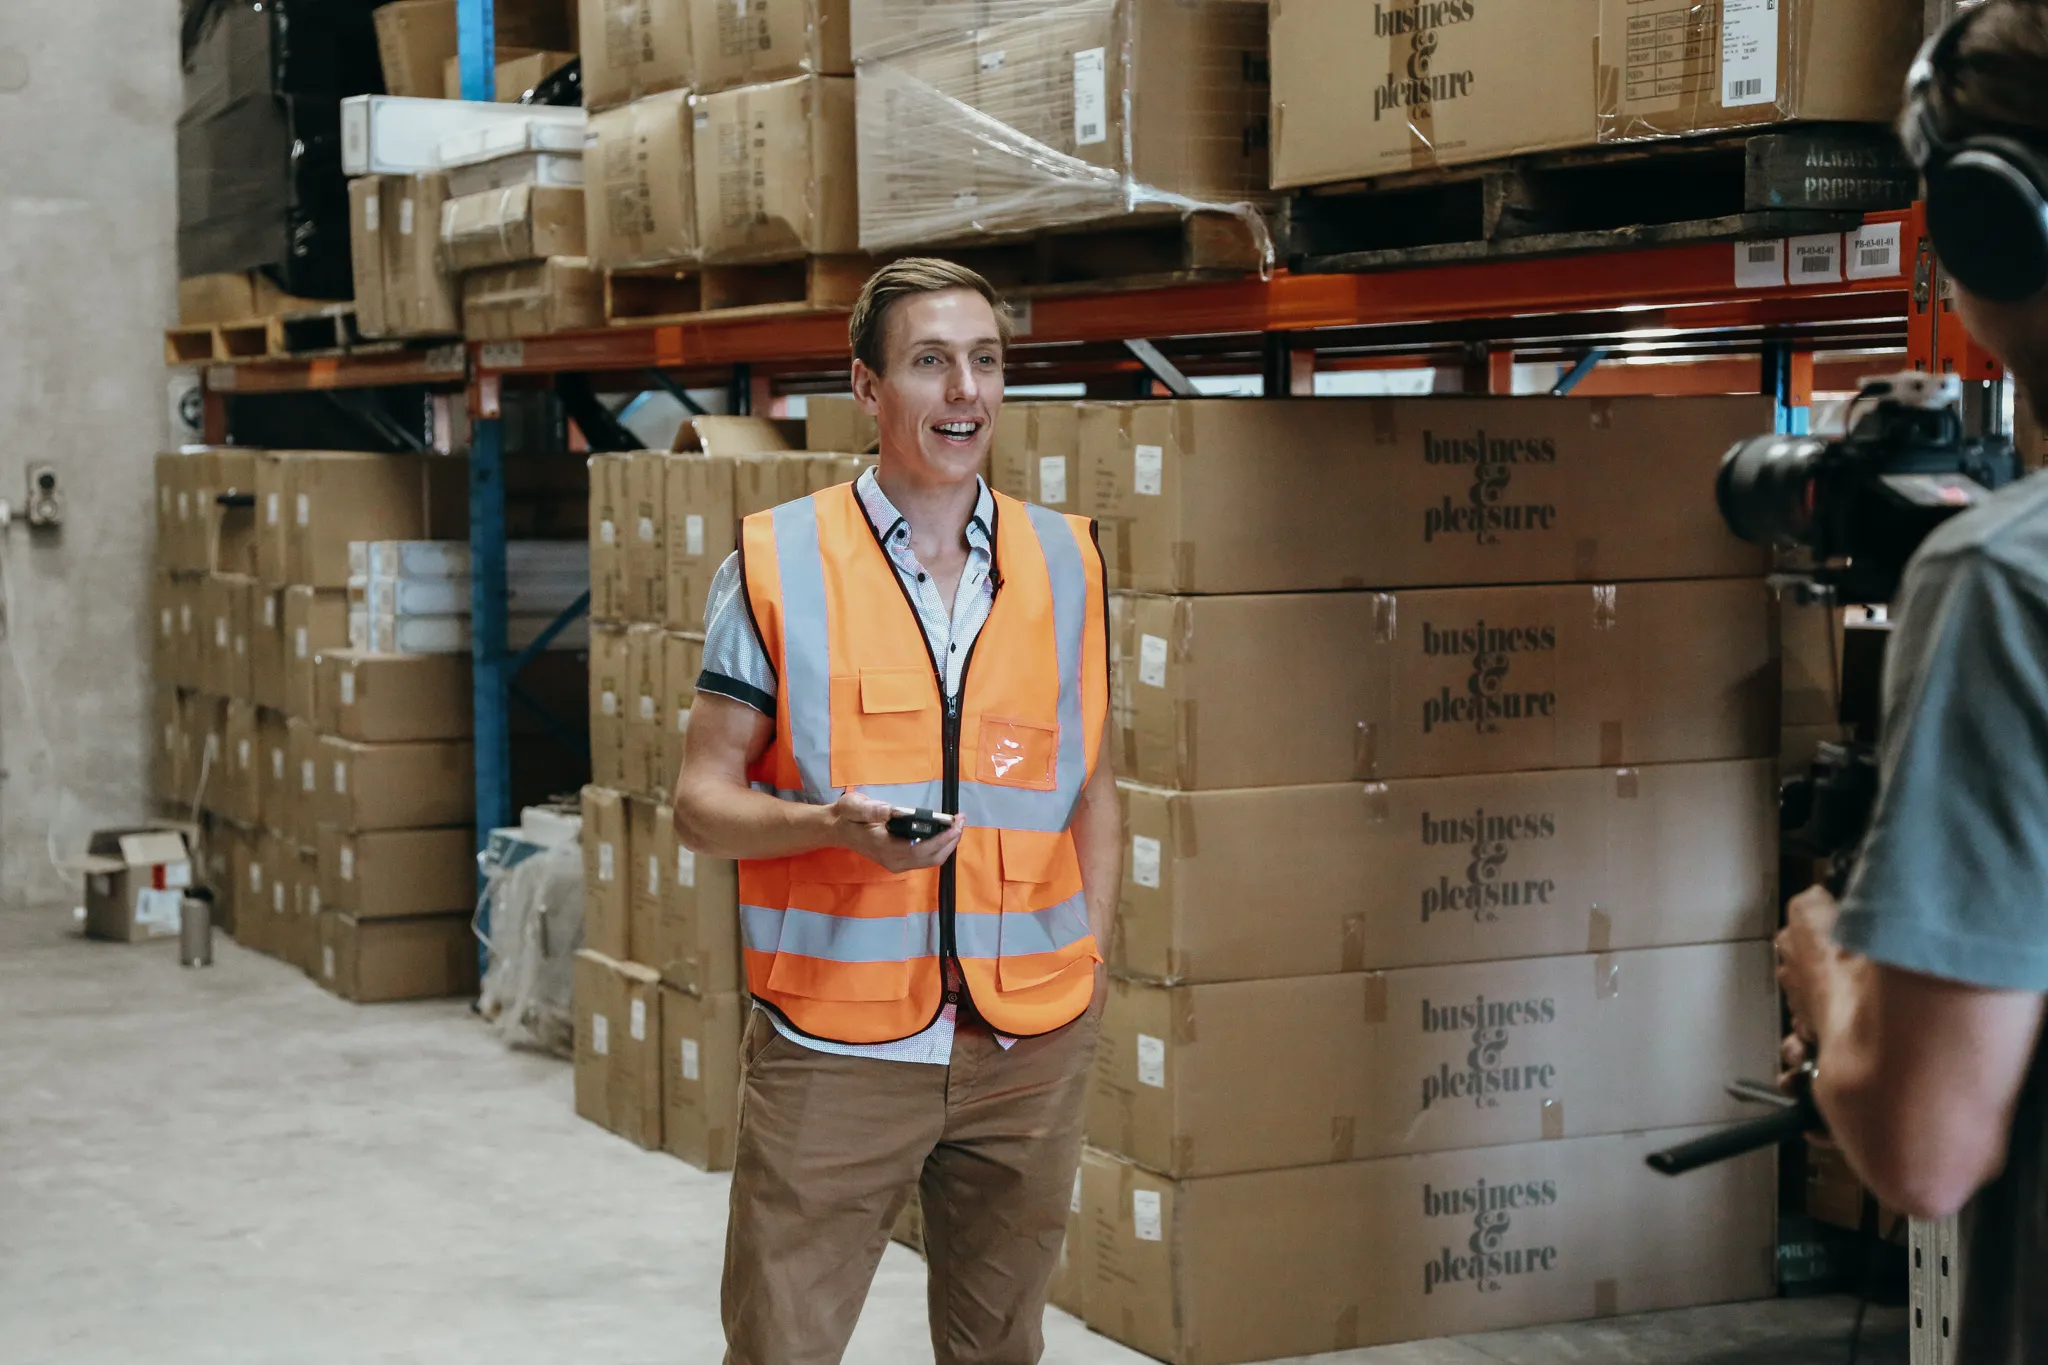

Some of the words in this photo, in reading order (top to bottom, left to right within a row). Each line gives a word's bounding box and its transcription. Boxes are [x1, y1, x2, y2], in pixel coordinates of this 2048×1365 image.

[1373, 0, 1475, 37] business
[1407, 30, 1439, 80] &
[1374, 69, 1475, 121] pleasure
[1854, 238, 1894, 249] PB-03-01-01
[1422, 429, 1557, 465] business
[1468, 460, 1511, 507] &
[1424, 495, 1557, 543] pleasure
[1422, 619, 1556, 657] business
[1467, 653, 1510, 698] &
[1423, 685, 1557, 734] pleasure
[1421, 807, 1556, 846] business
[1466, 841, 1509, 886] &
[1420, 875, 1556, 923] pleasure
[1421, 994, 1556, 1032] business
[1466, 1026, 1510, 1073] &
[1420, 1062, 1557, 1110] pleasure
[1422, 1178, 1558, 1218] business
[1468, 1209, 1511, 1256] &
[1423, 1245, 1558, 1295] pleasure
